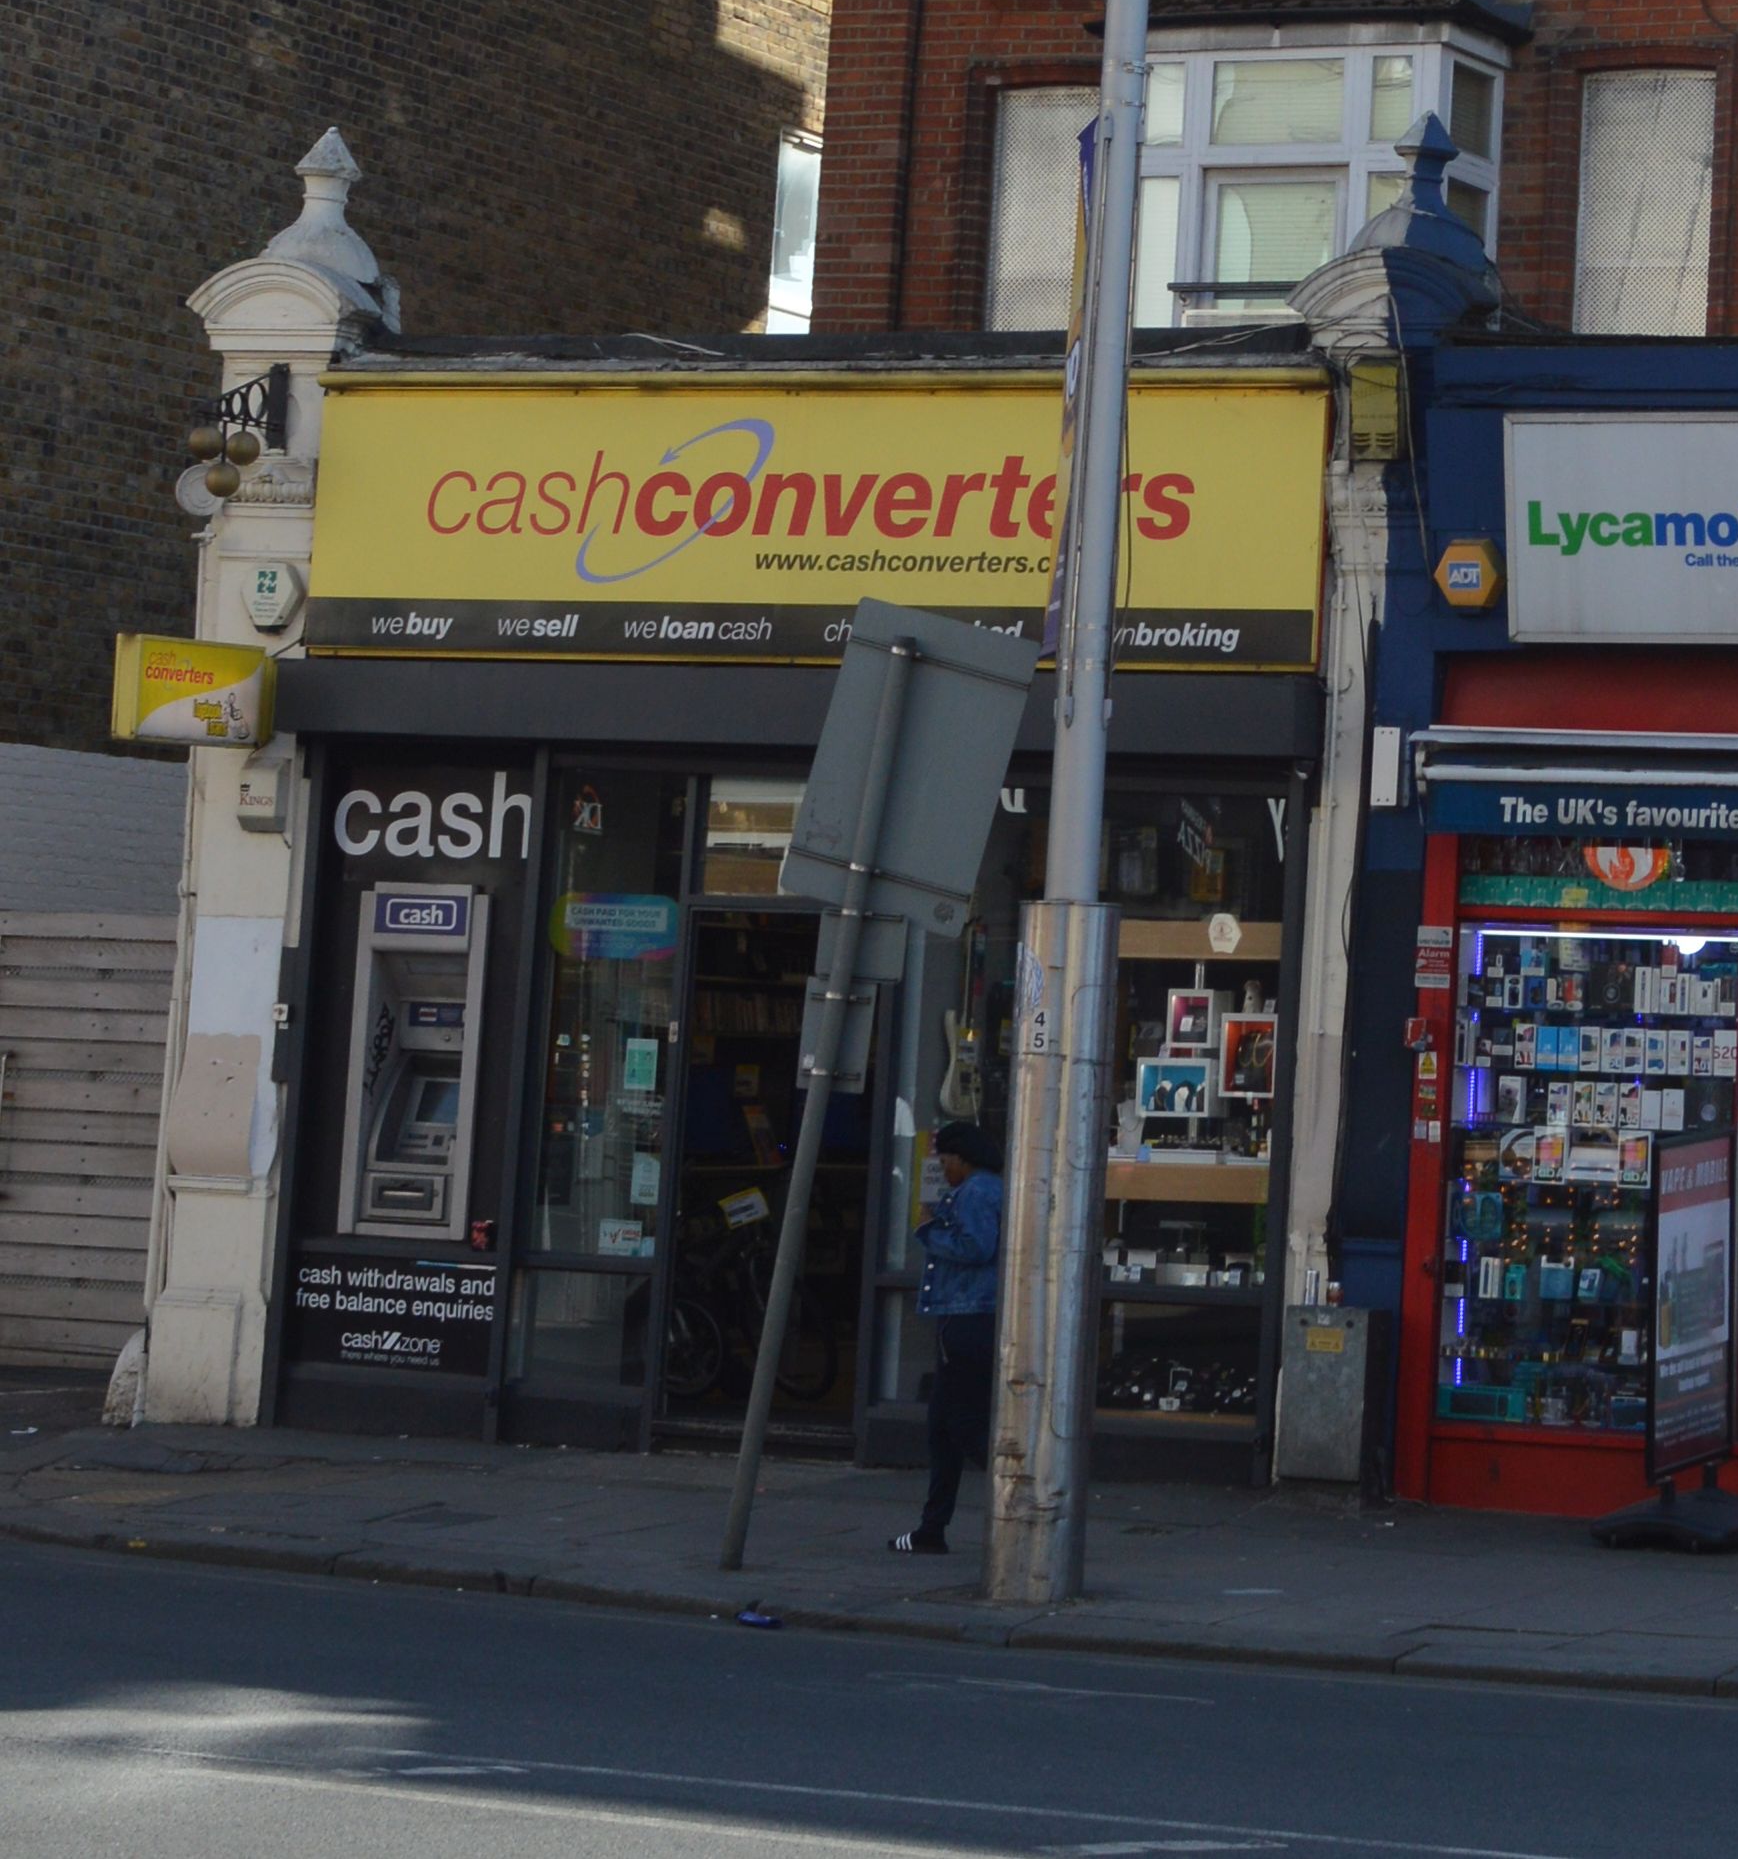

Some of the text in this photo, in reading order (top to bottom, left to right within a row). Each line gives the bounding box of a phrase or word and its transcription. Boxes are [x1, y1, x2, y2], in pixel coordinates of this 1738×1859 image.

[1685, 552, 1713, 567] Call
[1449, 567, 1480, 584] ADT
[371, 611, 454, 640] we buy
[497, 613, 579, 637] we sell
[623, 615, 773, 641] we loan cash
[145, 664, 215, 685] converters
[333, 771, 532, 859] cash
[1499, 797, 1548, 824] The
[1556, 798, 1617, 825] UK's
[399, 904, 443, 925] cash
[1418, 948, 1450, 958] Alarm
[298, 1264, 497, 1296] cash withdrawals and
[296, 1287, 494, 1323] free balance enquiries
